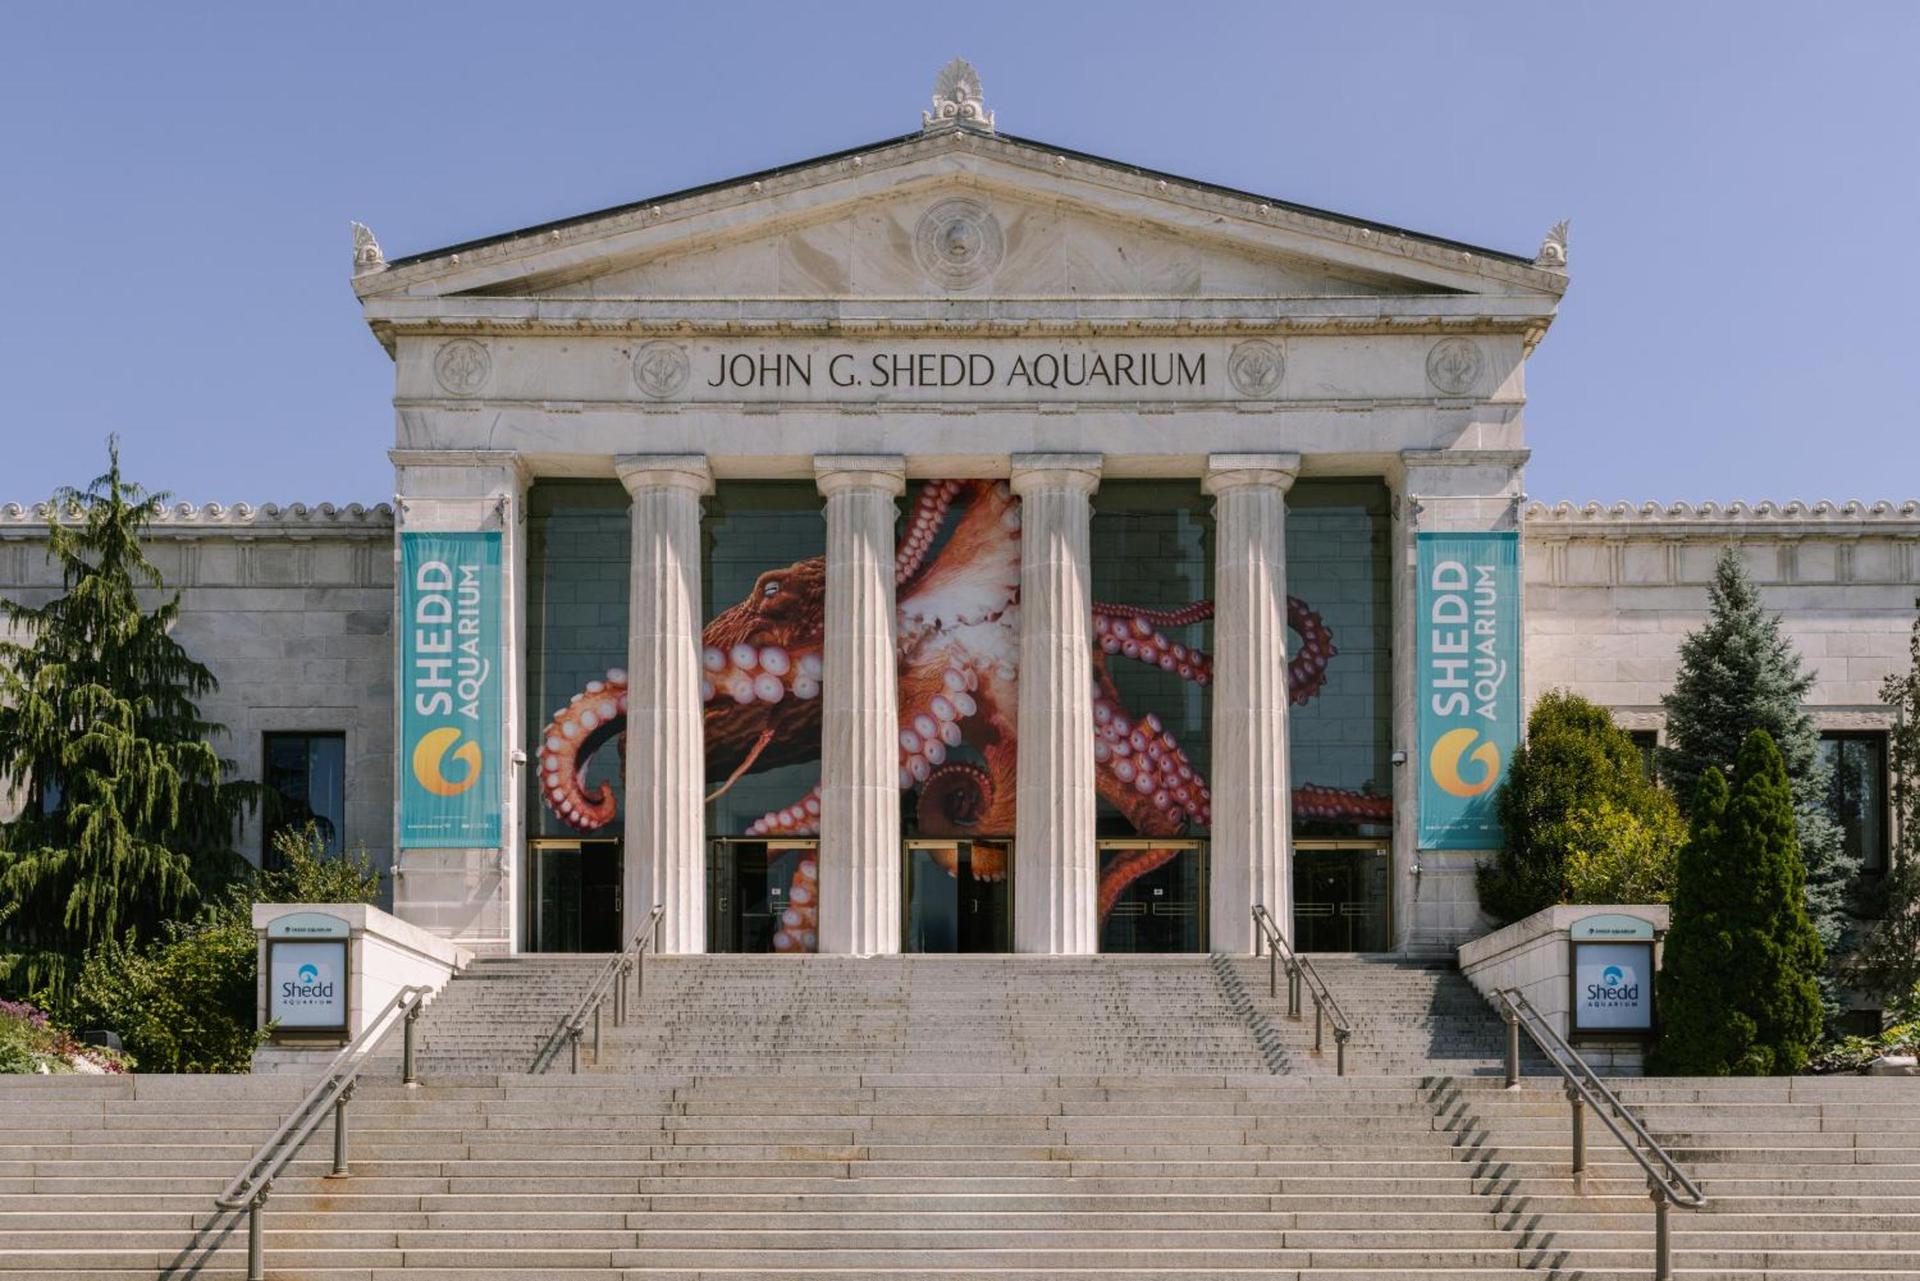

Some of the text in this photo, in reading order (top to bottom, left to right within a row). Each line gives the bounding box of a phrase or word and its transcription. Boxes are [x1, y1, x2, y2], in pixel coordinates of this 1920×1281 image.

[708, 353, 1206, 389] JOHN G. SHEDD AQUARIUM
[415, 561, 453, 716] SHEDD
[457, 564, 490, 720] AQUARIUM
[1431, 561, 1469, 717] SHEDD
[1474, 565, 1507, 721] AQUARIUM
[282, 981, 334, 998] Shedd
[1587, 983, 1639, 1001] Shedd
